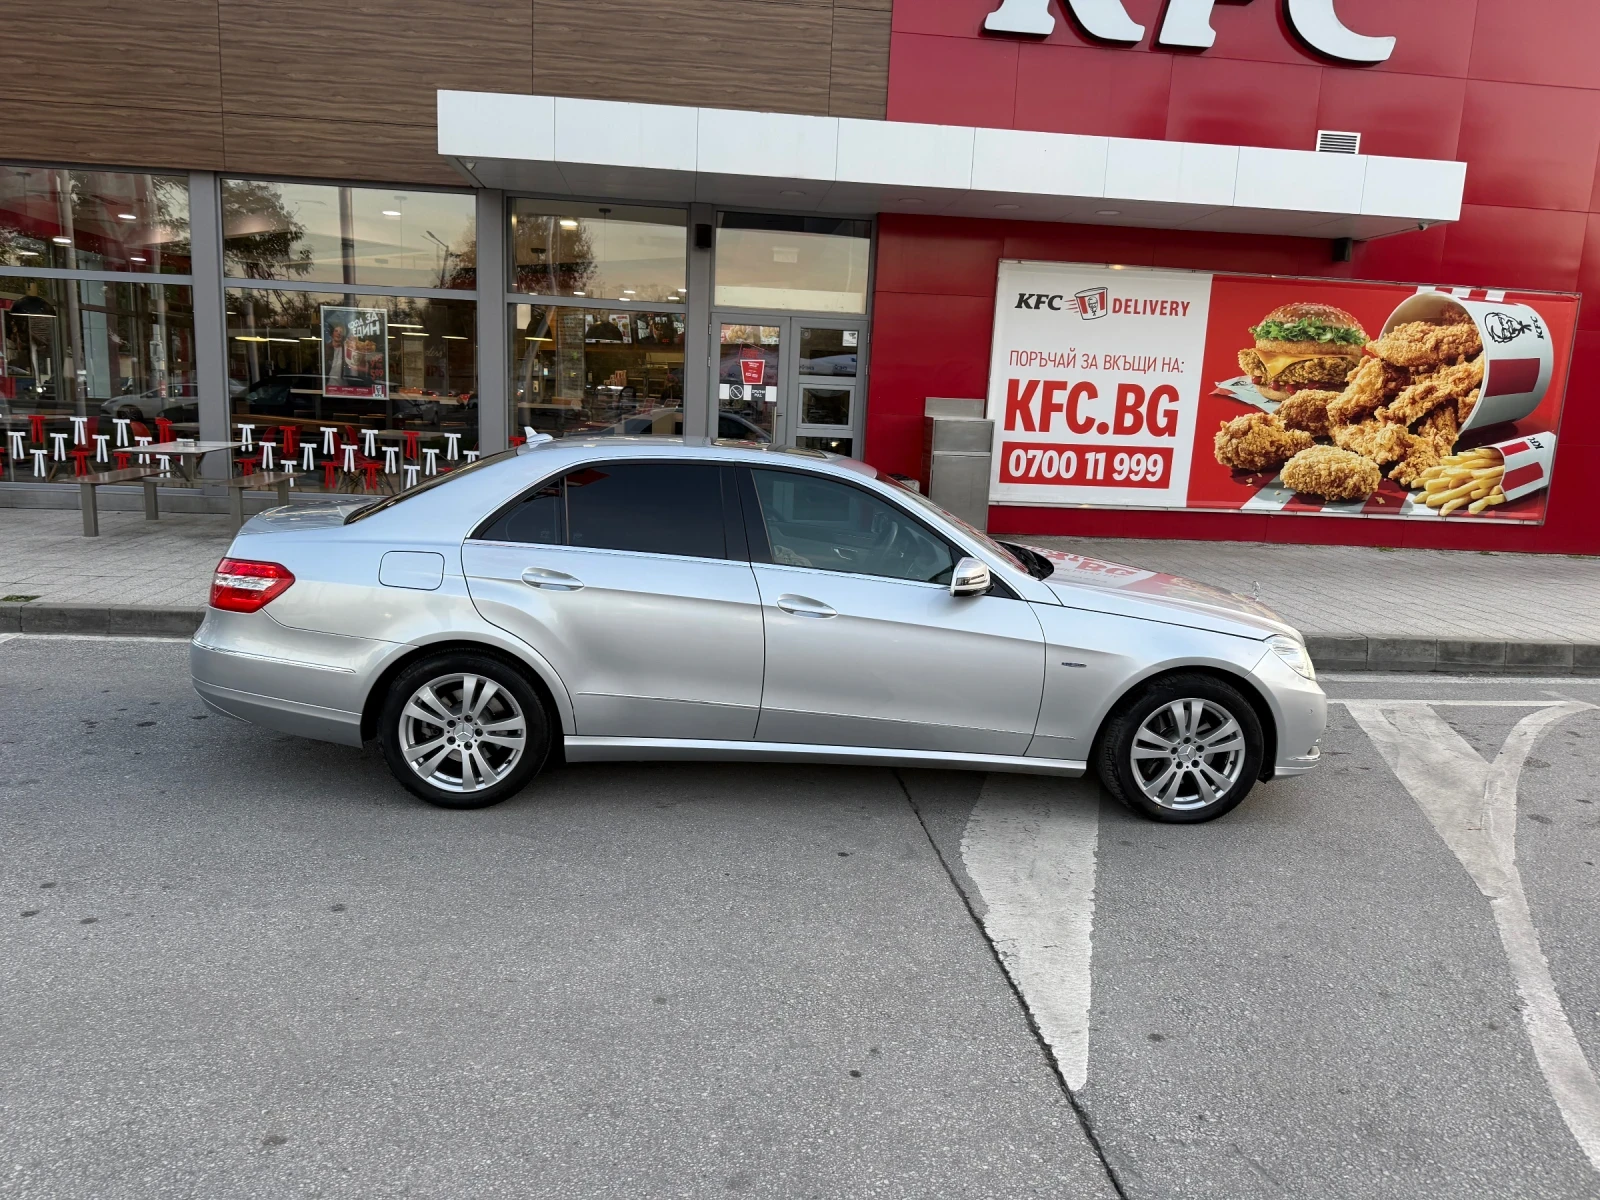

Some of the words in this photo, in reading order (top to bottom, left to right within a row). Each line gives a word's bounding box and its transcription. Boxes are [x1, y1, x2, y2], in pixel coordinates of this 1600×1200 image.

[365, 311, 378, 323] ЗА
[1014, 292, 1064, 311] KFC
[1112, 298, 1191, 317] DELIVERY
[352, 321, 380, 338] ЕДИН
[1530, 315, 1544, 340] KFC
[1009, 347, 1077, 368] ПОРЪЧАЙ
[1081, 353, 1098, 370] ЗА
[1103, 355, 1157, 374] ВКЪЩИ
[1161, 358, 1185, 374] НА:
[1004, 378, 1180, 437] KFC.BG
[1527, 436, 1545, 450] KFC
[1008, 448, 1078, 479] 0700
[1084, 451, 1107, 480] 11
[1112, 452, 1165, 482] 999
